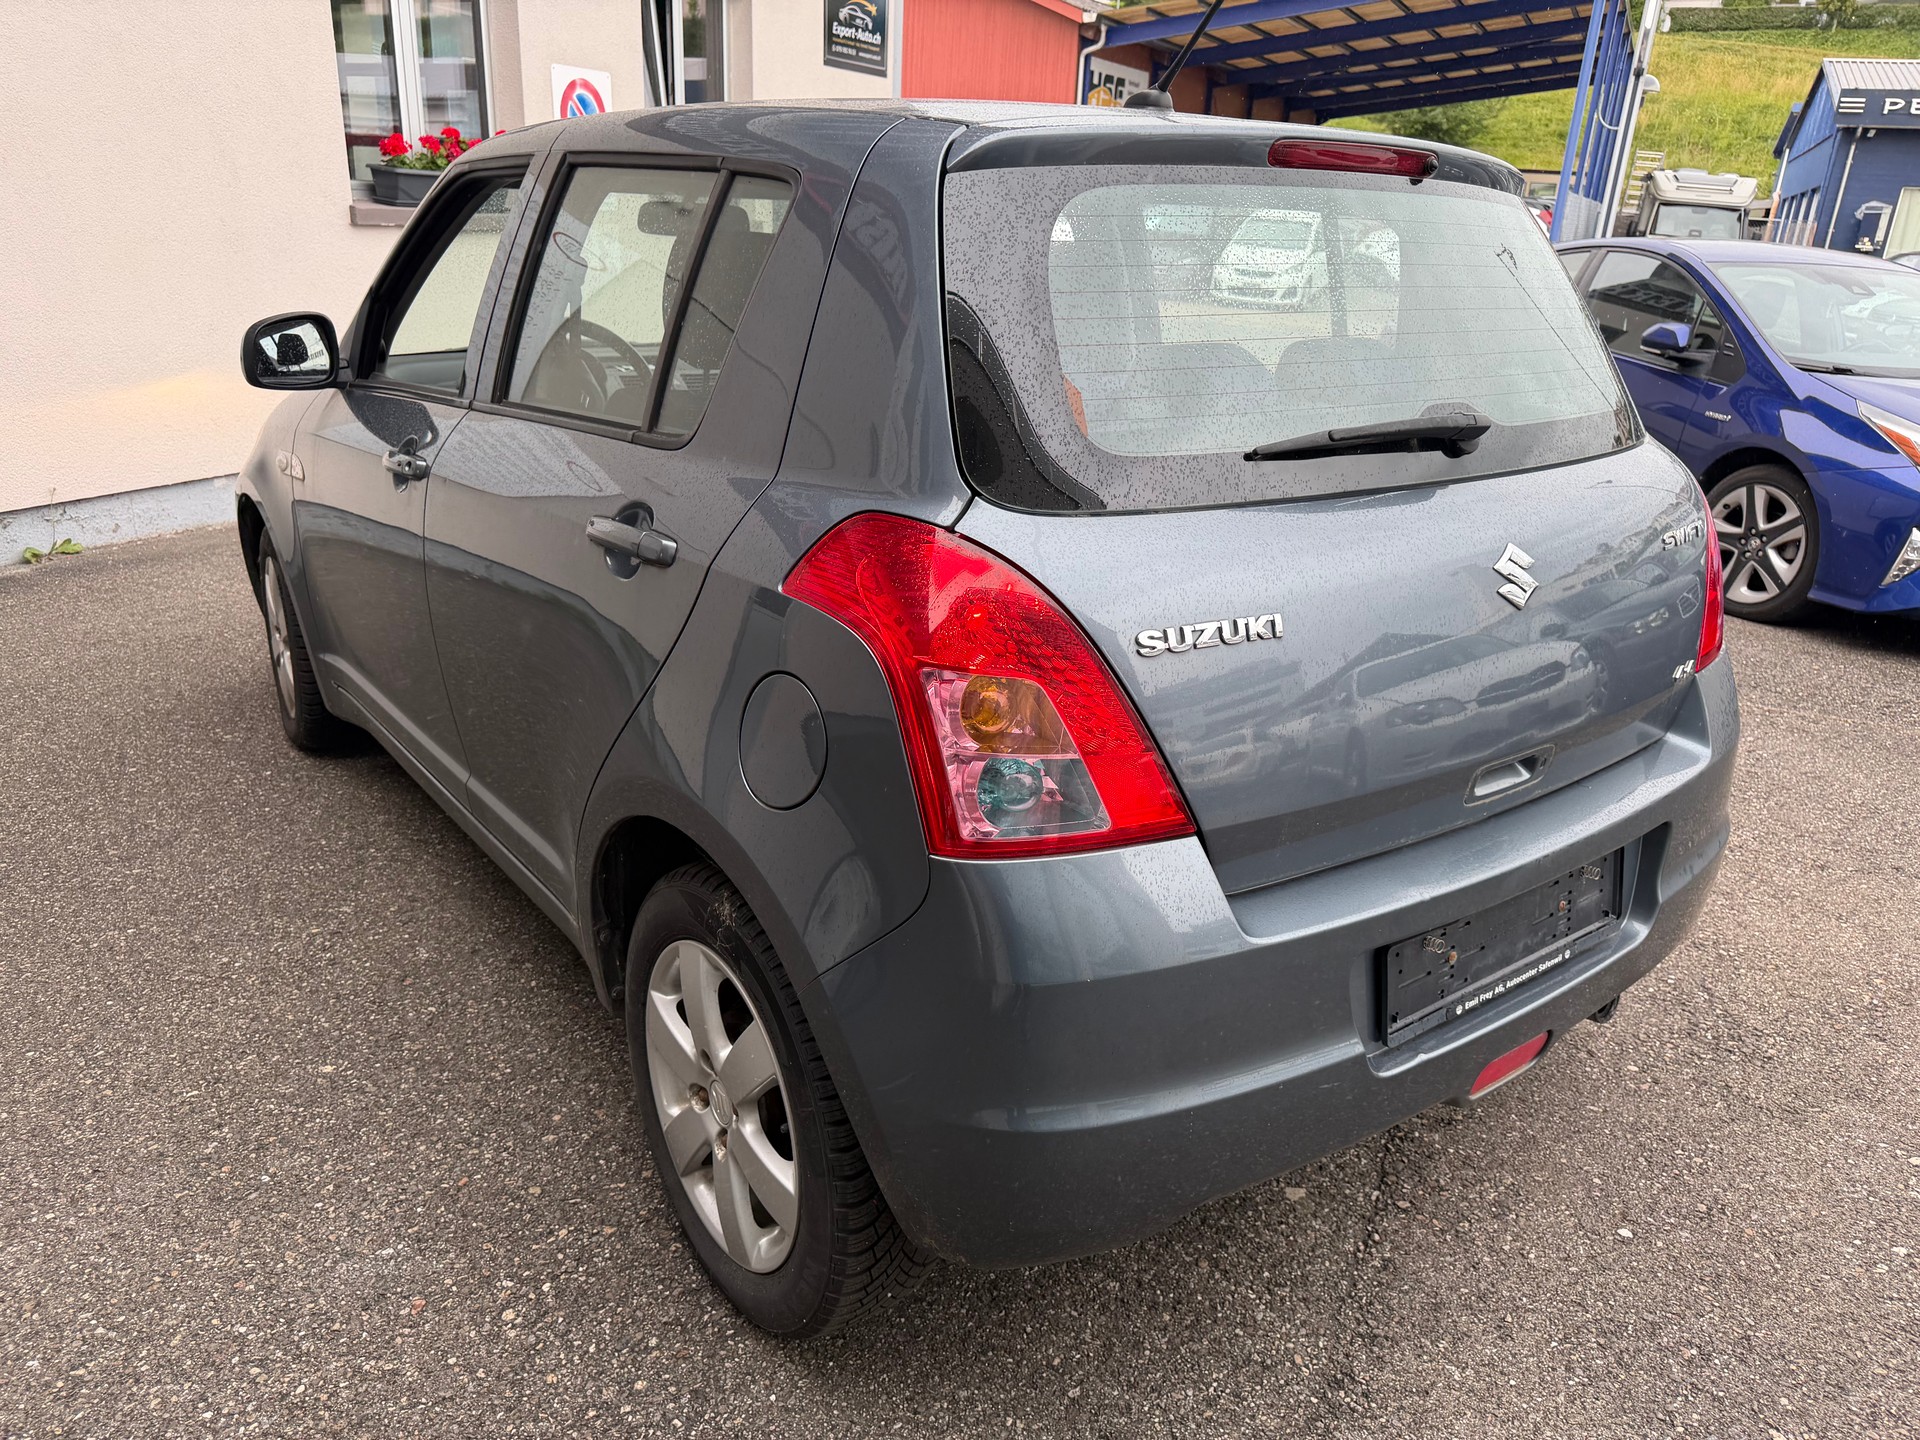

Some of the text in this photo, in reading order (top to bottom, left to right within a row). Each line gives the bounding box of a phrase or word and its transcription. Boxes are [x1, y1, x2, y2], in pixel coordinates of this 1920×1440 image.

[832, 21, 882, 45] Export-Auto.ch
[1661, 519, 1704, 551] SWIFT
[1135, 612, 1284, 657] SUZUKI
[1465, 953, 1563, 1010] Emil Frey AG, Autocenter Safenwil
